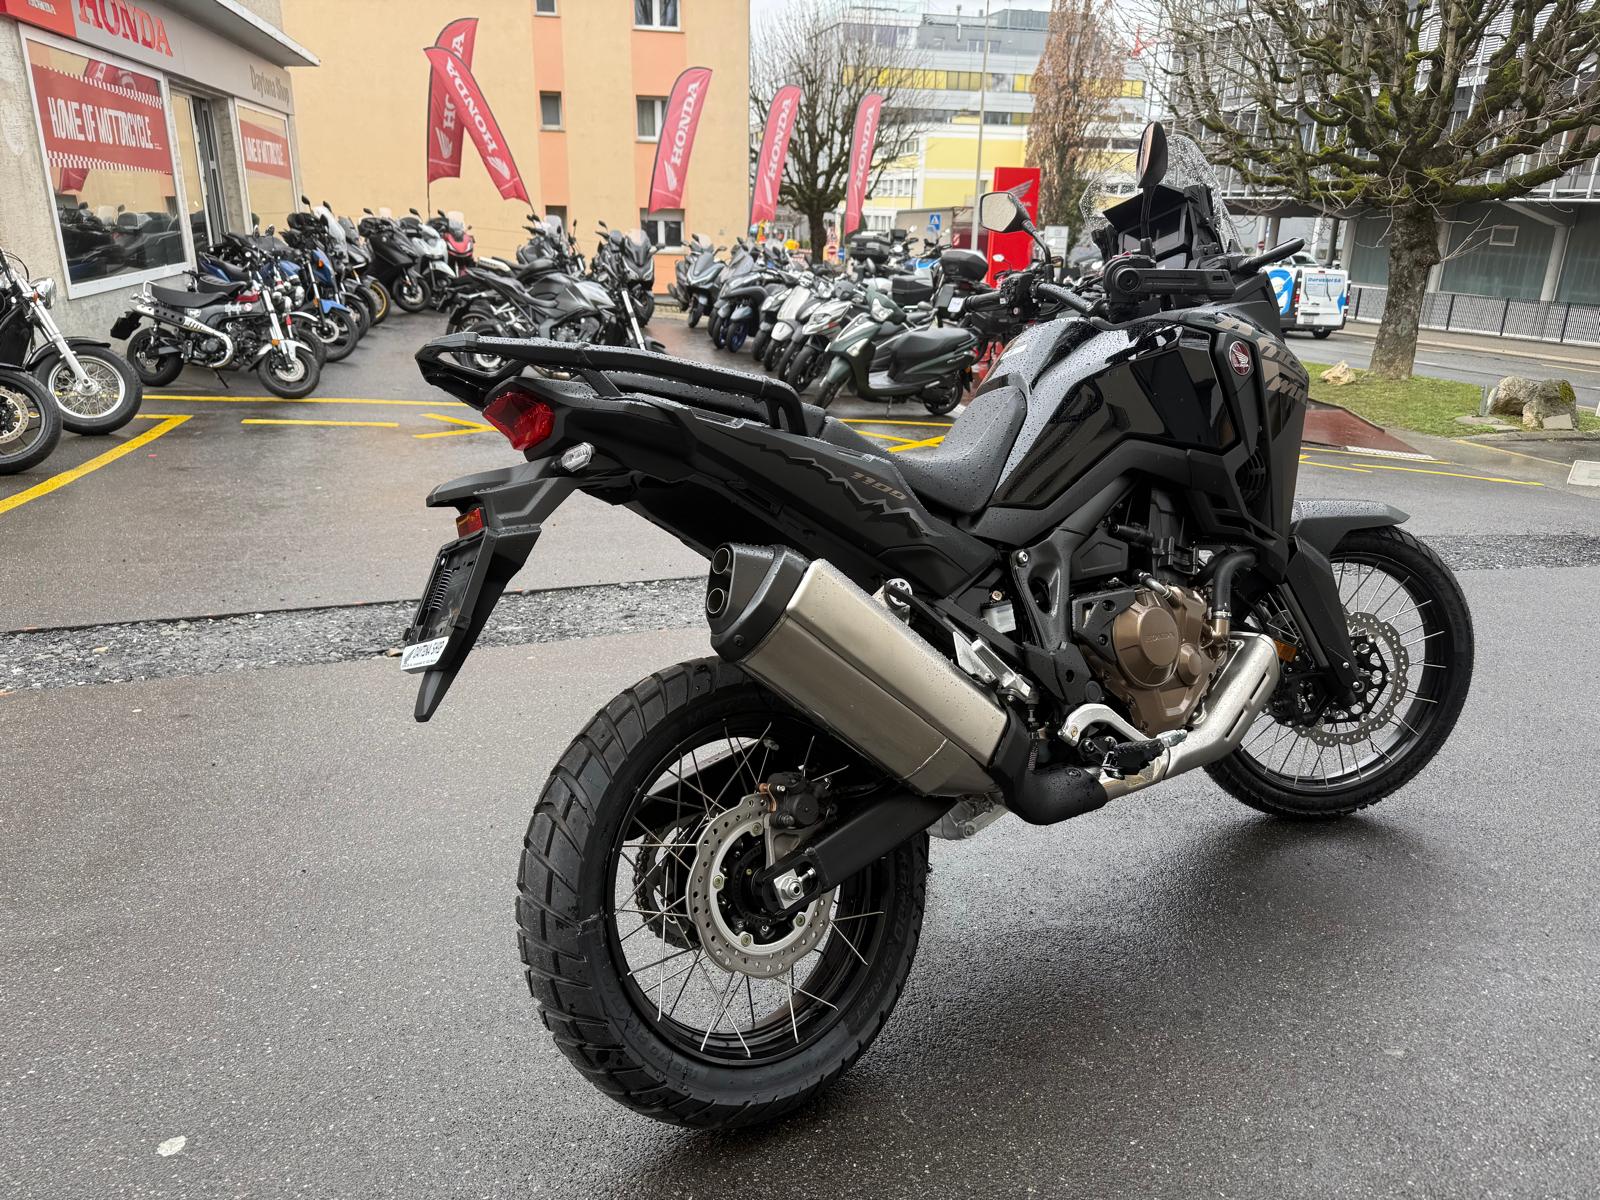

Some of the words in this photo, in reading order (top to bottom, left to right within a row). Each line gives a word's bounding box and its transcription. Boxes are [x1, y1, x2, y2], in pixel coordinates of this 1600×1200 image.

[79, 0, 174, 57] HONDA
[47, 96, 85, 141] HOME
[82, 103, 97, 143] OF
[446, 57, 498, 153] HONDA
[670, 81, 700, 166] HONDA
[767, 97, 792, 180] HONDA
[856, 105, 875, 190] HONDA
